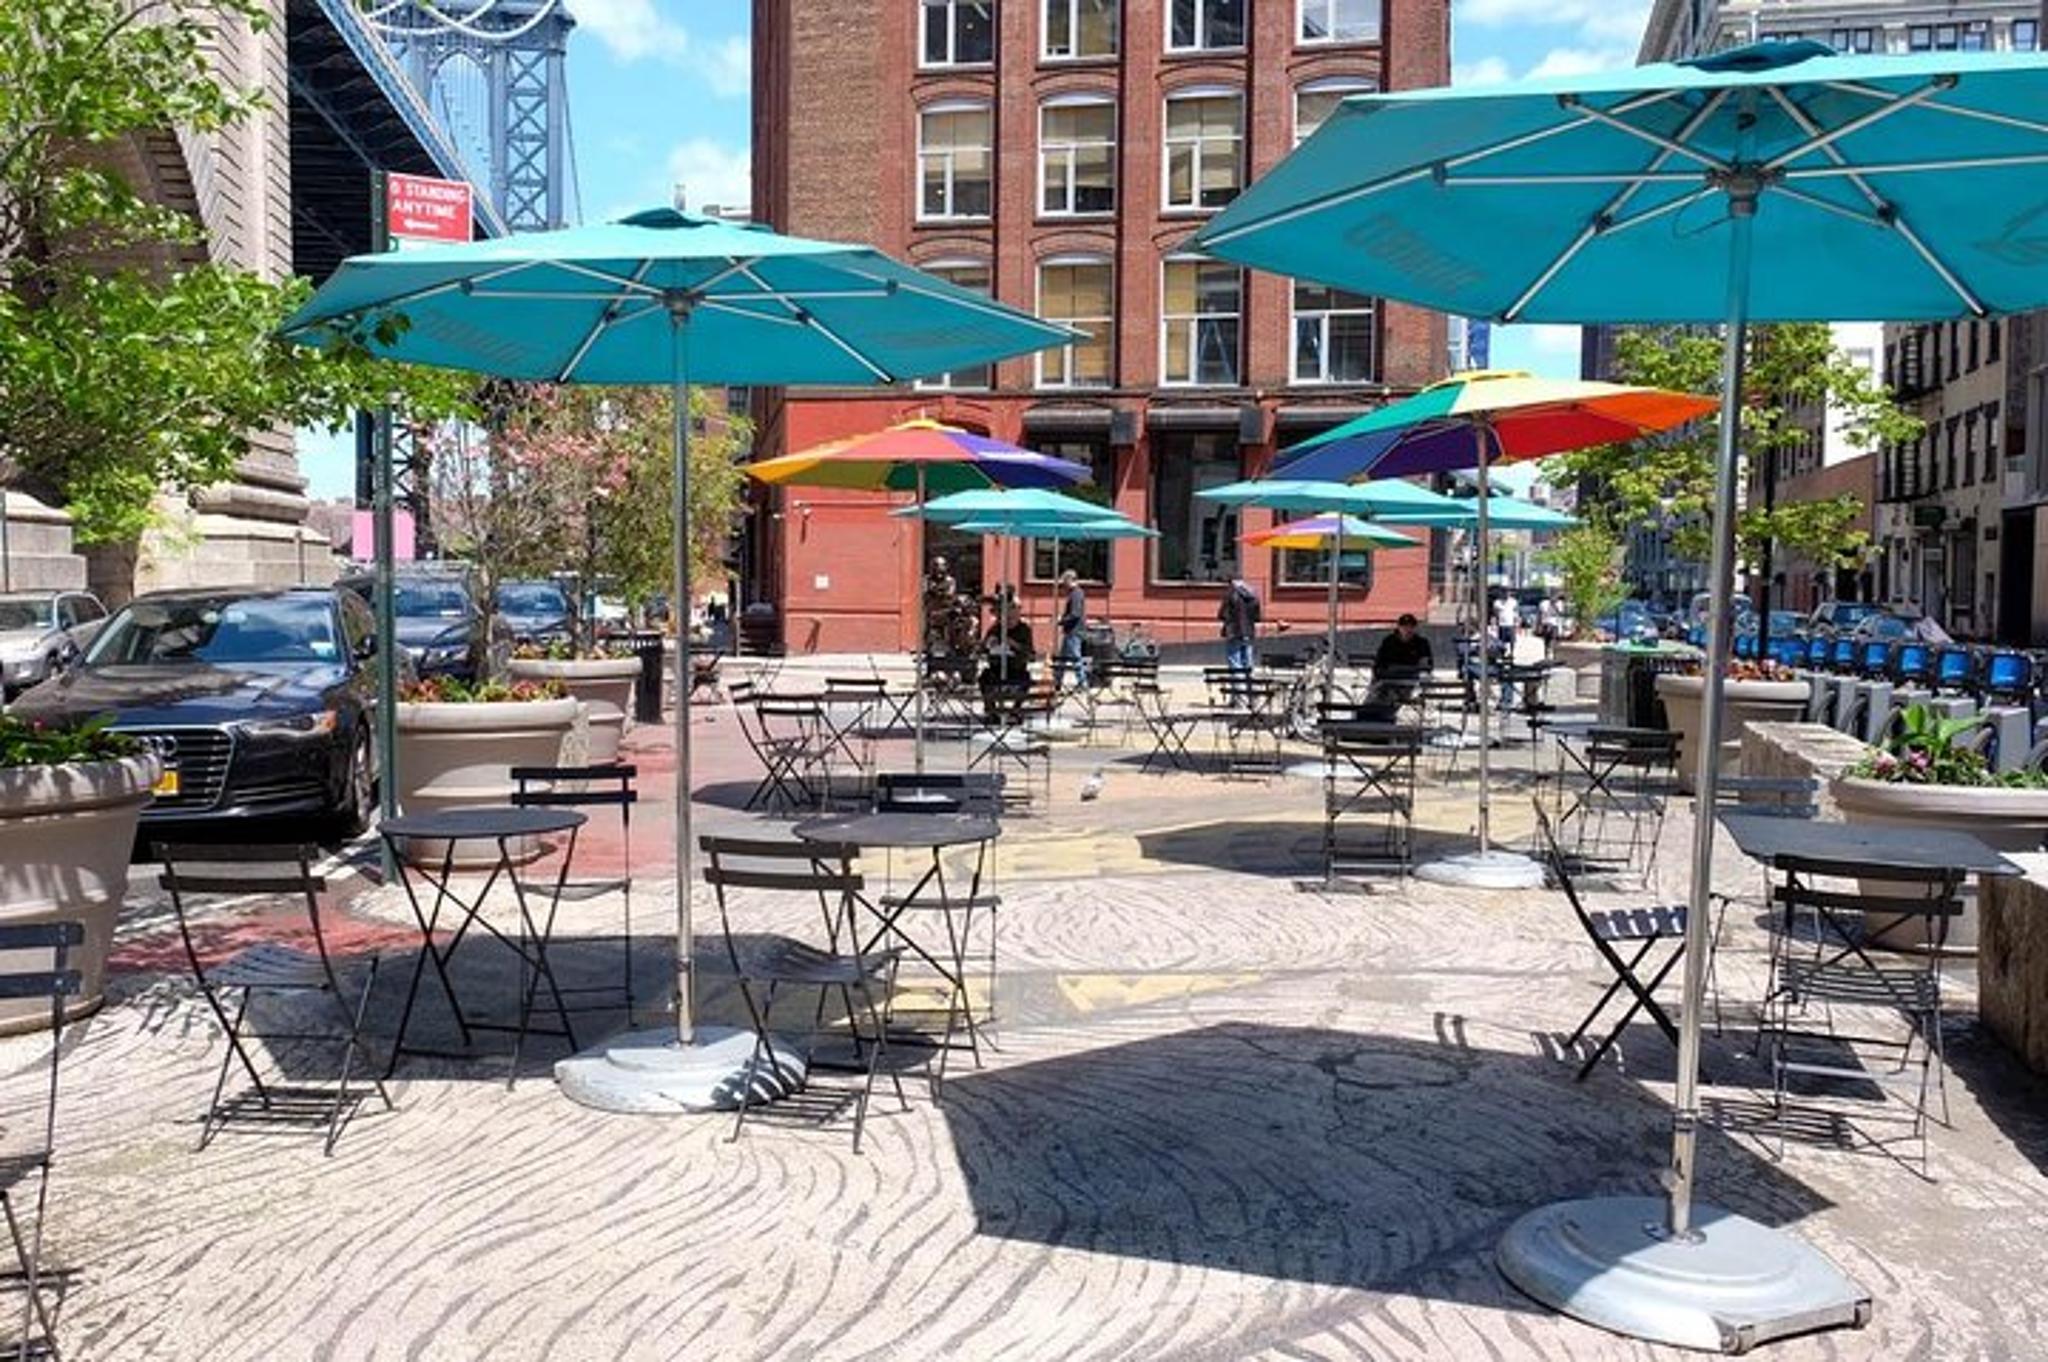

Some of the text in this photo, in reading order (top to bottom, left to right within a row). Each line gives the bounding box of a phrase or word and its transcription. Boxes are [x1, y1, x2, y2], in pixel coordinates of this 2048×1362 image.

[390, 181, 467, 204] O STANDING
[392, 199, 456, 218] ANYTIME
